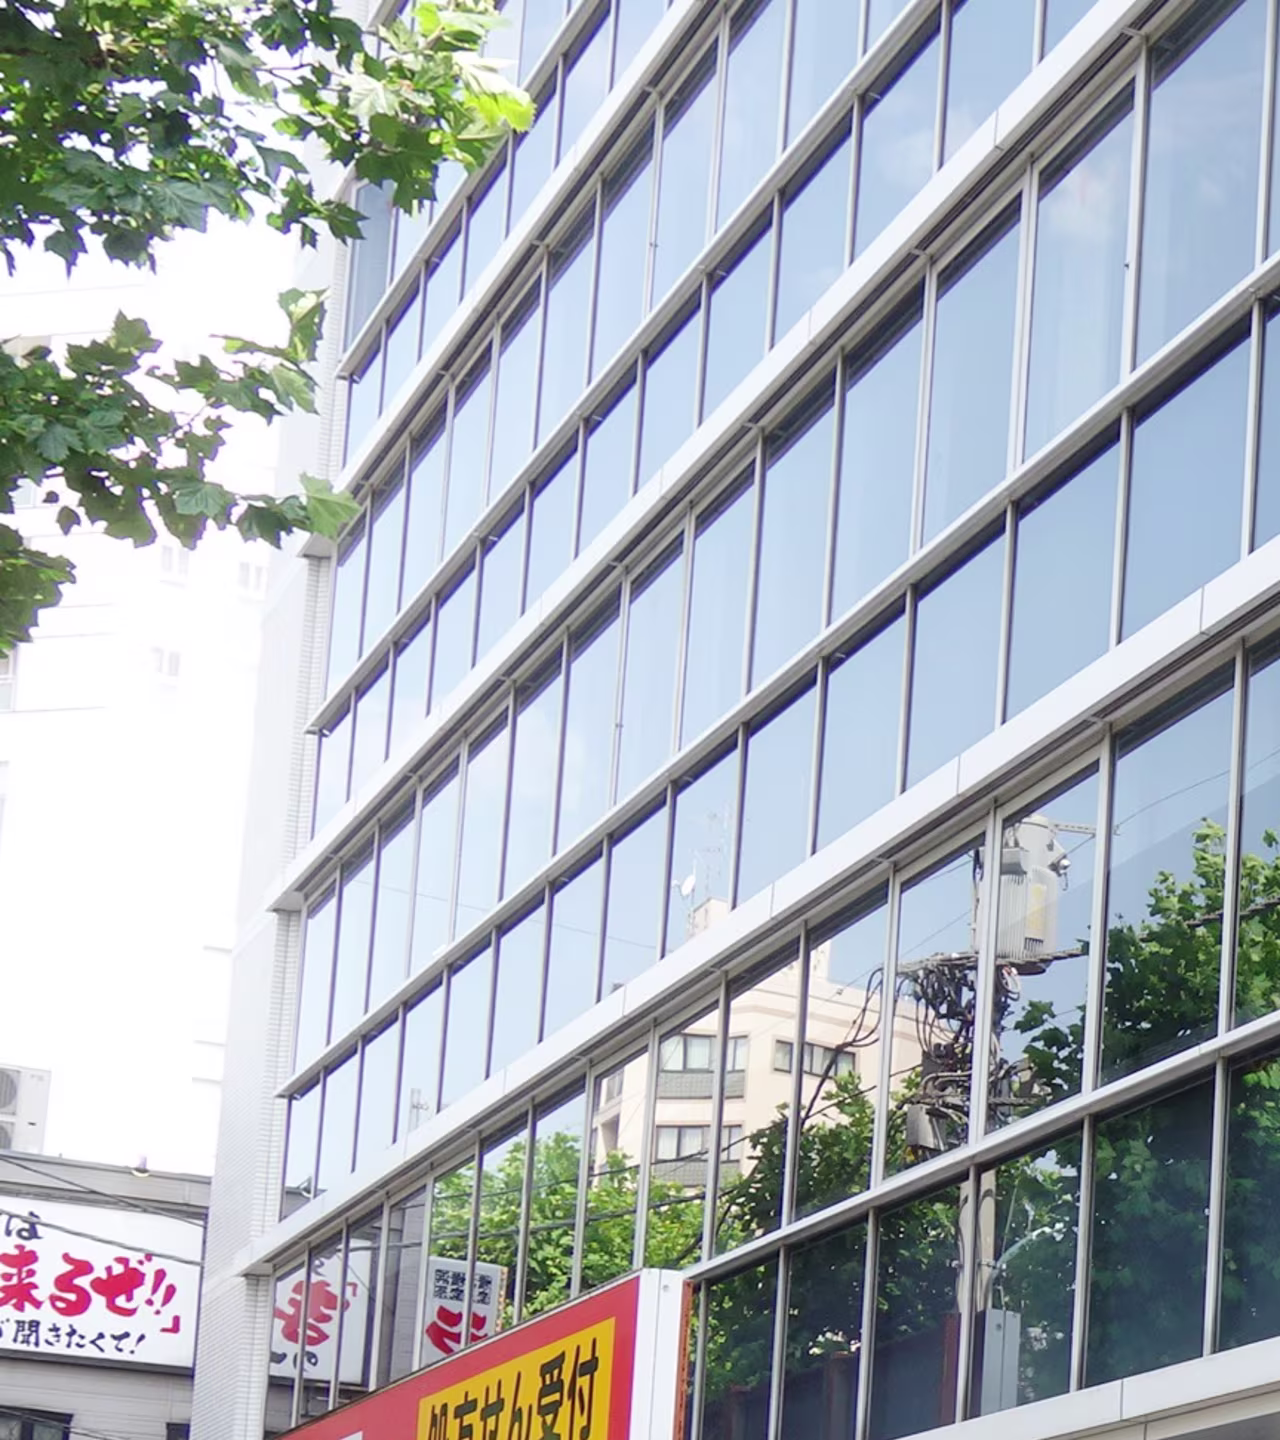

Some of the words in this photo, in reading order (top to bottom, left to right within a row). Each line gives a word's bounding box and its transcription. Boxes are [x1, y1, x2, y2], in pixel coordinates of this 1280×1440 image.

[0, 1318, 146, 1354] 聞きたくて!
